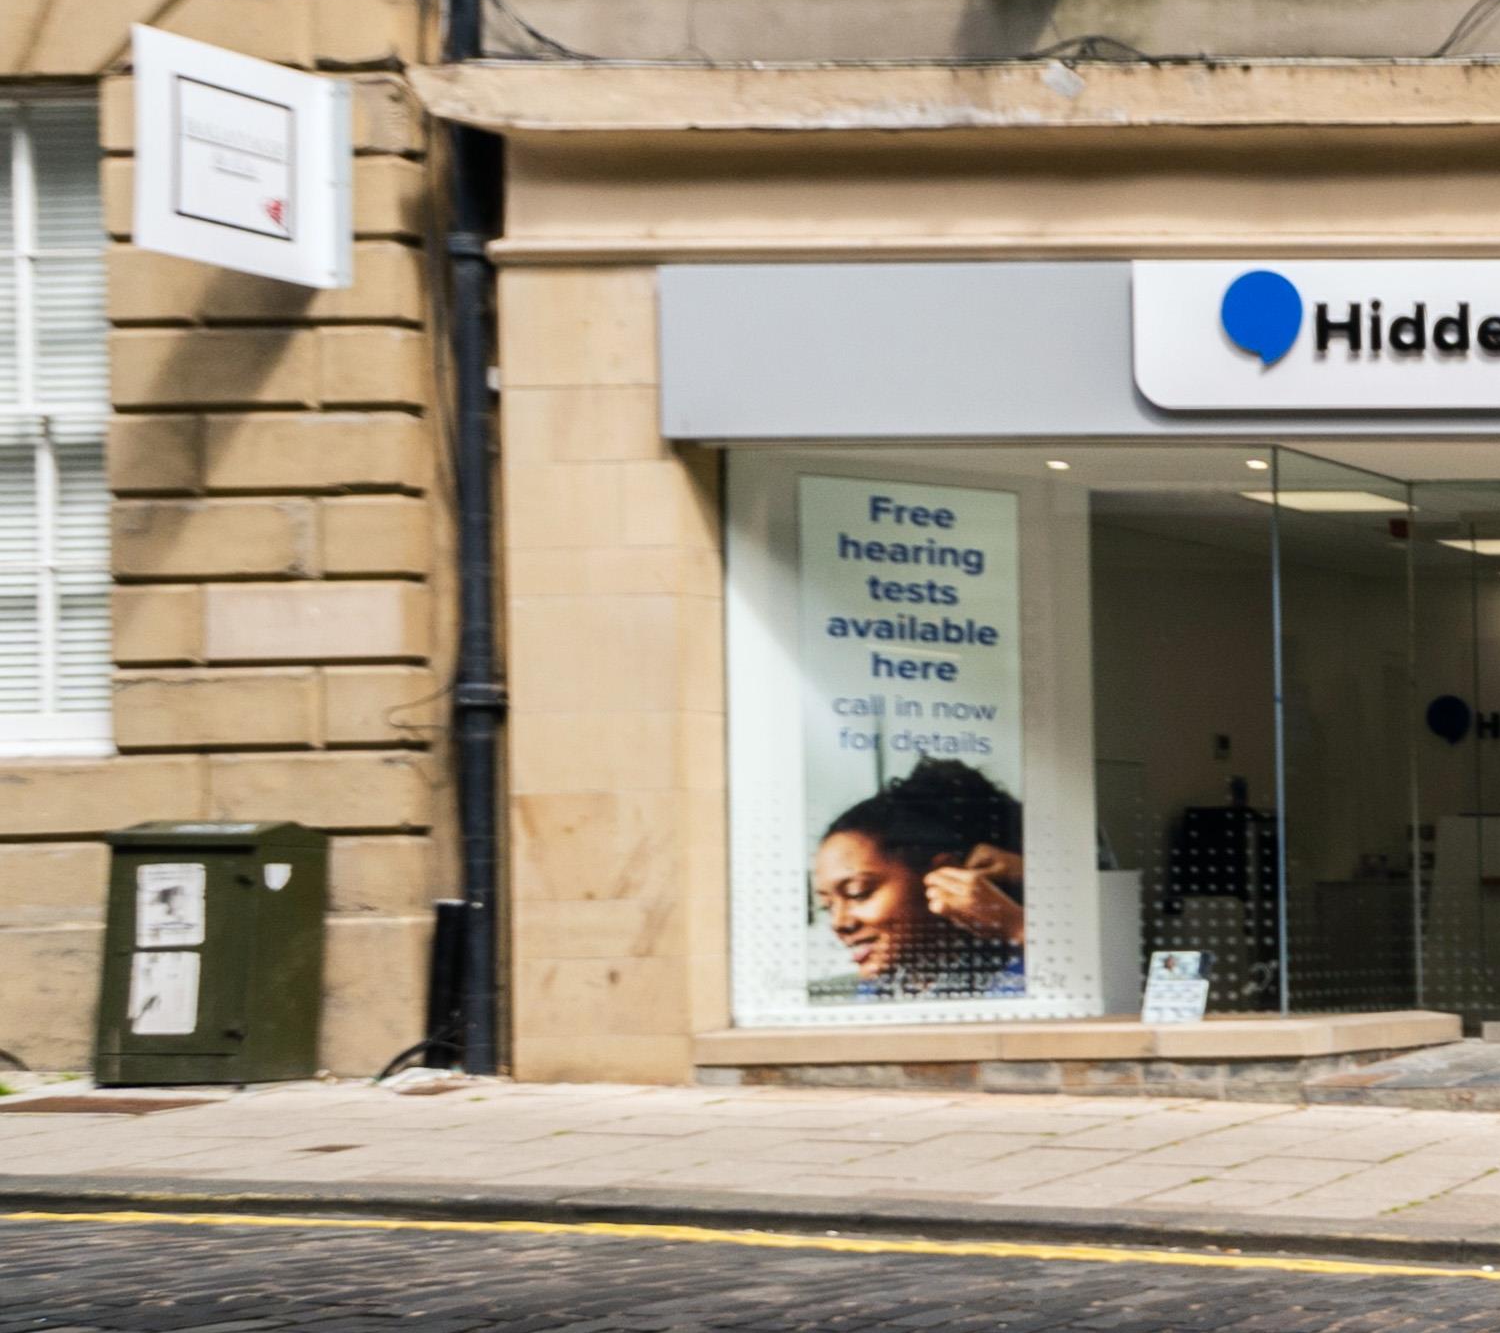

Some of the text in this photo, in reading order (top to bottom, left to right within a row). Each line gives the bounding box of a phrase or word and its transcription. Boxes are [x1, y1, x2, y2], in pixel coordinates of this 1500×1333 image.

[869, 495, 957, 529] Free
[838, 533, 985, 576] hearing
[867, 575, 960, 606] tests
[826, 613, 999, 646] available
[871, 651, 959, 681] here
[832, 695, 998, 721] call in now
[840, 727, 993, 755] for details
